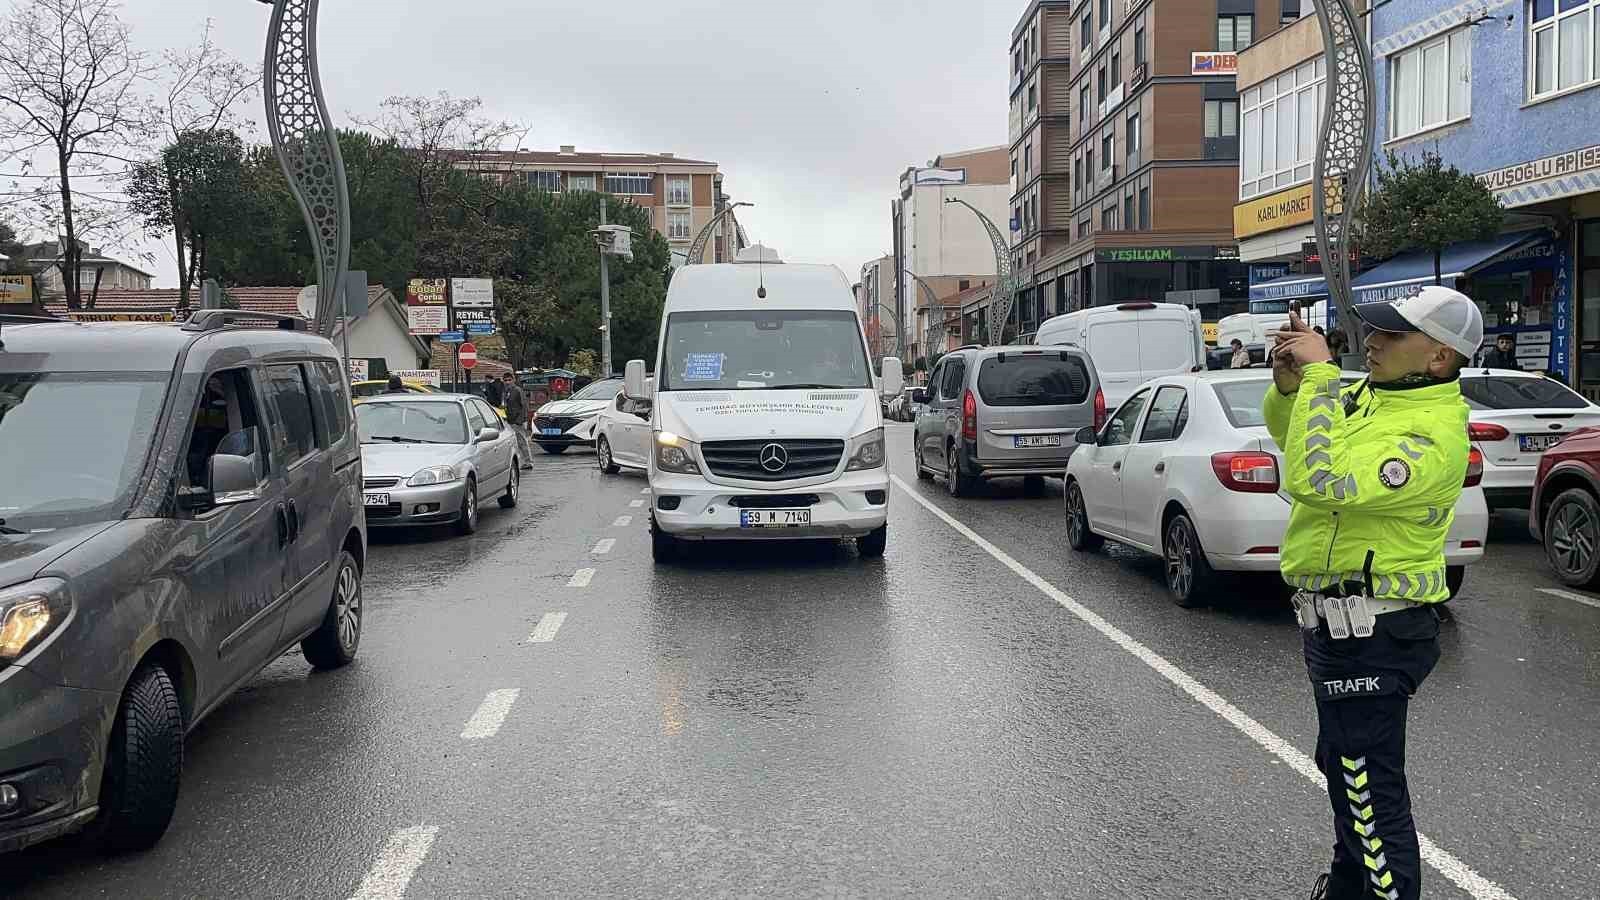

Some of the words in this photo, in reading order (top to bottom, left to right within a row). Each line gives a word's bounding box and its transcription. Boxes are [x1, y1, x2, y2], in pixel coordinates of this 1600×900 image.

[1473, 160, 1552, 191] AVUŞOĞLU
[1257, 205, 1279, 223] KARLI
[1280, 195, 1312, 217] MARKET
[748, 511, 761, 523] 59
[769, 511, 776, 523] M
[784, 511, 809, 523] 7140
[1323, 676, 1381, 696] TRAFİK
